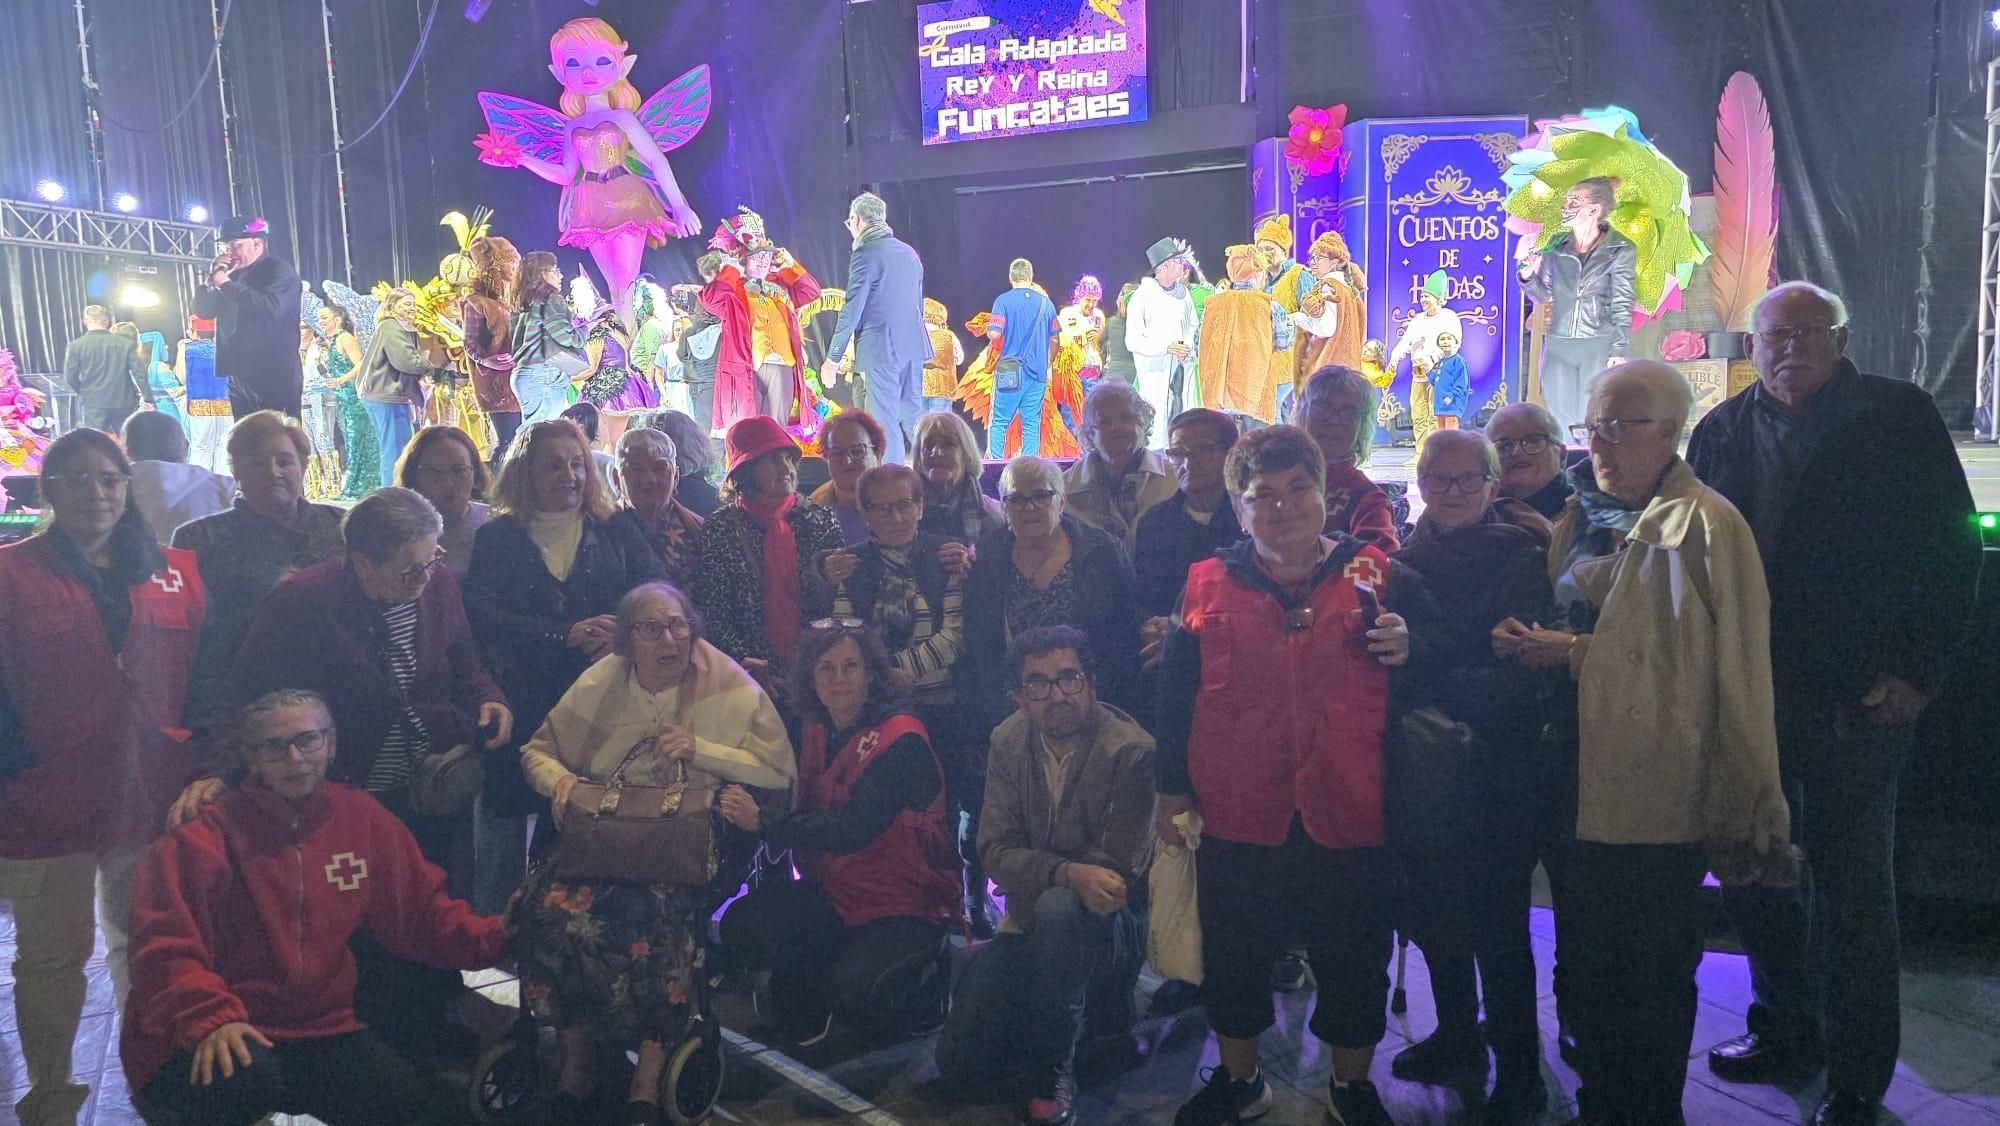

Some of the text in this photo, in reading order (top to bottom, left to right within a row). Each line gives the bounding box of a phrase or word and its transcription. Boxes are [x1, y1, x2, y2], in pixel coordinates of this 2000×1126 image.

[931, 30, 1127, 67] Gala Adaptada
[1038, 69, 1108, 91] Reina
[1399, 215, 1499, 247] CUENTOS
[1440, 249, 1460, 268] DE
[1408, 274, 1486, 304] HDAS
